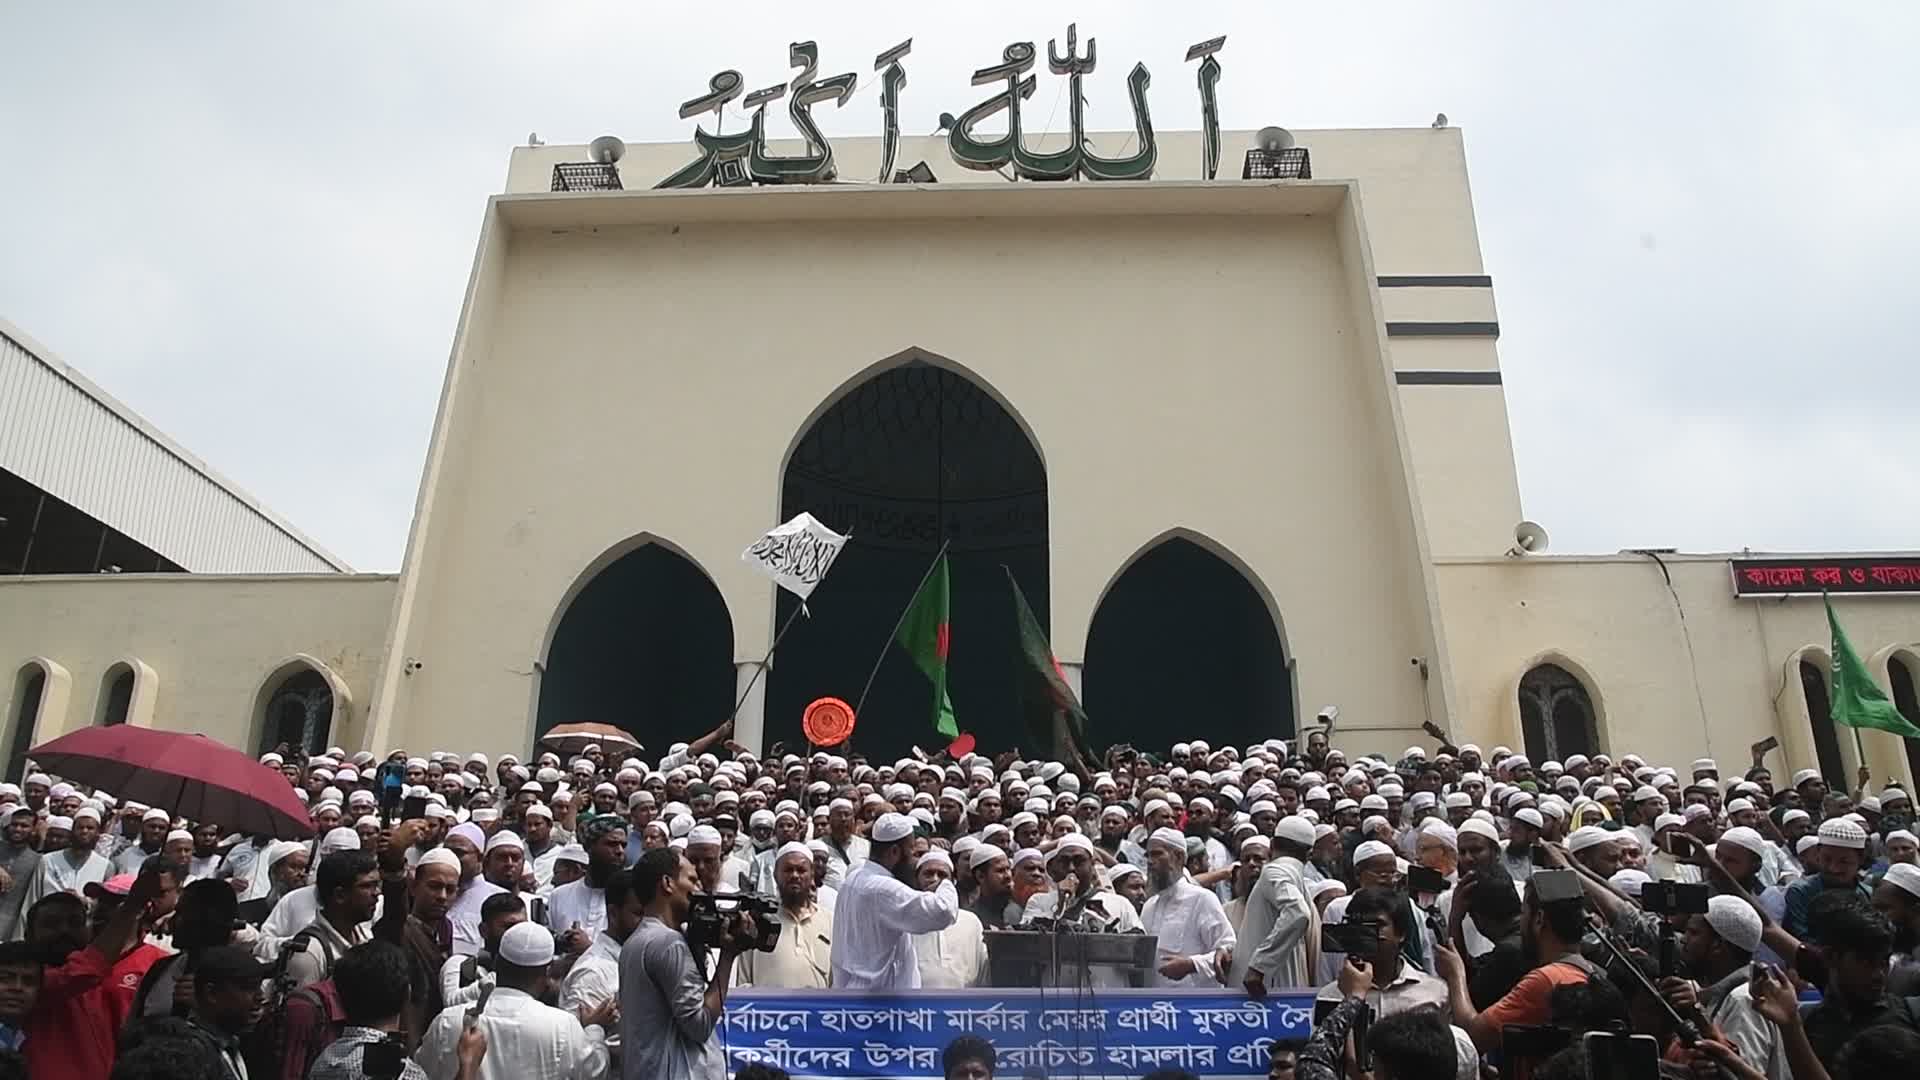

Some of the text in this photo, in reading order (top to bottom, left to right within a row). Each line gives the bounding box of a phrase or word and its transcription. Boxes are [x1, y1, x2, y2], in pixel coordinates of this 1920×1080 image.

[1743, 567, 1805, 585] কায়েম
[1808, 567, 1842, 584] কর
[1848, 567, 1866, 584] ও
[818, 1007, 936, 1033] হাতপাখা
[944, 1002, 1028, 1032] মার্কার
[1117, 1001, 1181, 1032] প্রার্থী
[1188, 1001, 1272, 1036] মুফতী
[721, 1039, 854, 1069] াকর্মীদের
[862, 1039, 939, 1070] উপর
[989, 1039, 1096, 1068] রোচিত
[1103, 1044, 1218, 1070] হামলার
